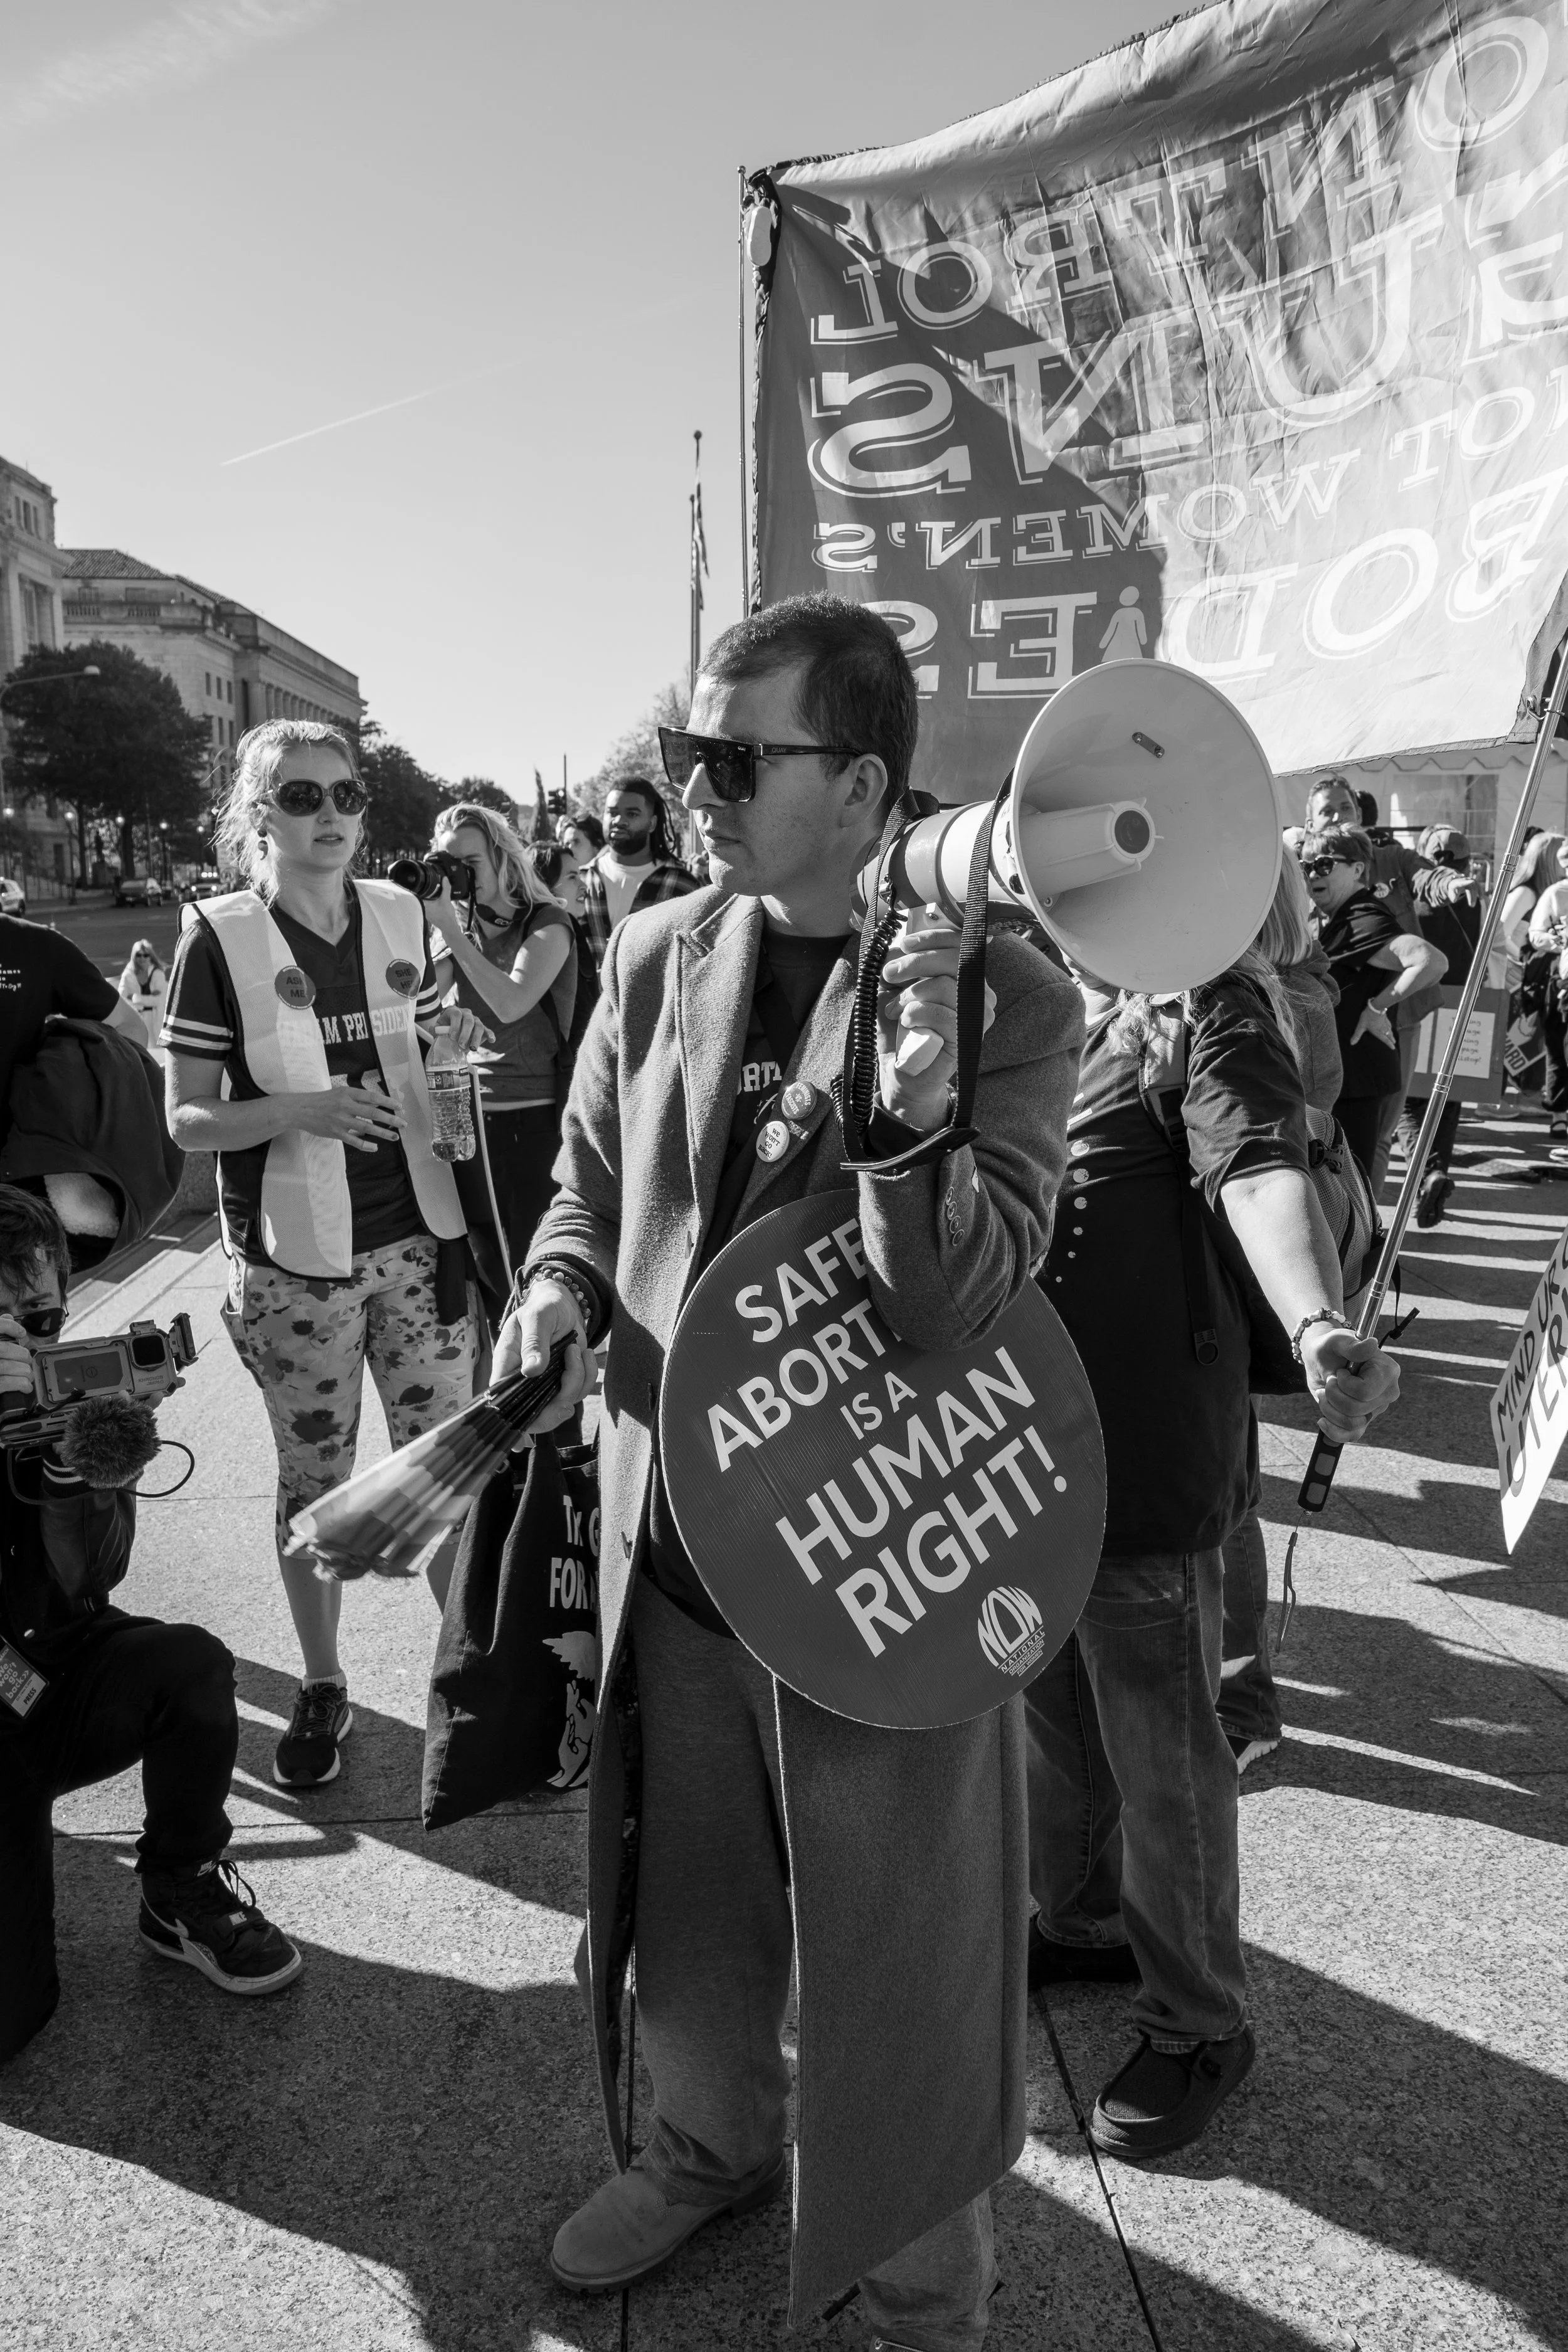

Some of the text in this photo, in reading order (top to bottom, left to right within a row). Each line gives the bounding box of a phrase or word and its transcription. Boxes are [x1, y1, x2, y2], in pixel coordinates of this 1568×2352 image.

[290, 989, 305, 998] ME
[395, 968, 412, 977] SHE
[785, 1093, 800, 1115] FASCISTS
[796, 1082, 812, 1106] FEMINISTS
[734, 1217, 872, 1343] SAFE
[1497, 1259, 1560, 1443] MIND UR
[706, 1300, 905, 1473] ABORT
[839, 1370, 918, 1441] IS A
[1505, 1287, 1568, 1498] UTER
[775, 1346, 1037, 1586] HUMAN
[835, 1427, 1068, 1658] RIGHT!
[549, 1557, 589, 1610] FOR
[977, 1585, 1043, 1668] NOW
[1000, 1630, 1046, 1673] NATIONAL
[1009, 1638, 1045, 1675] ORGANIZATION
[1017, 1648, 1043, 1675] FOR WOMEN
[8, 1671, 18, 1685] go
[23, 1687, 37, 1705] PRESS
